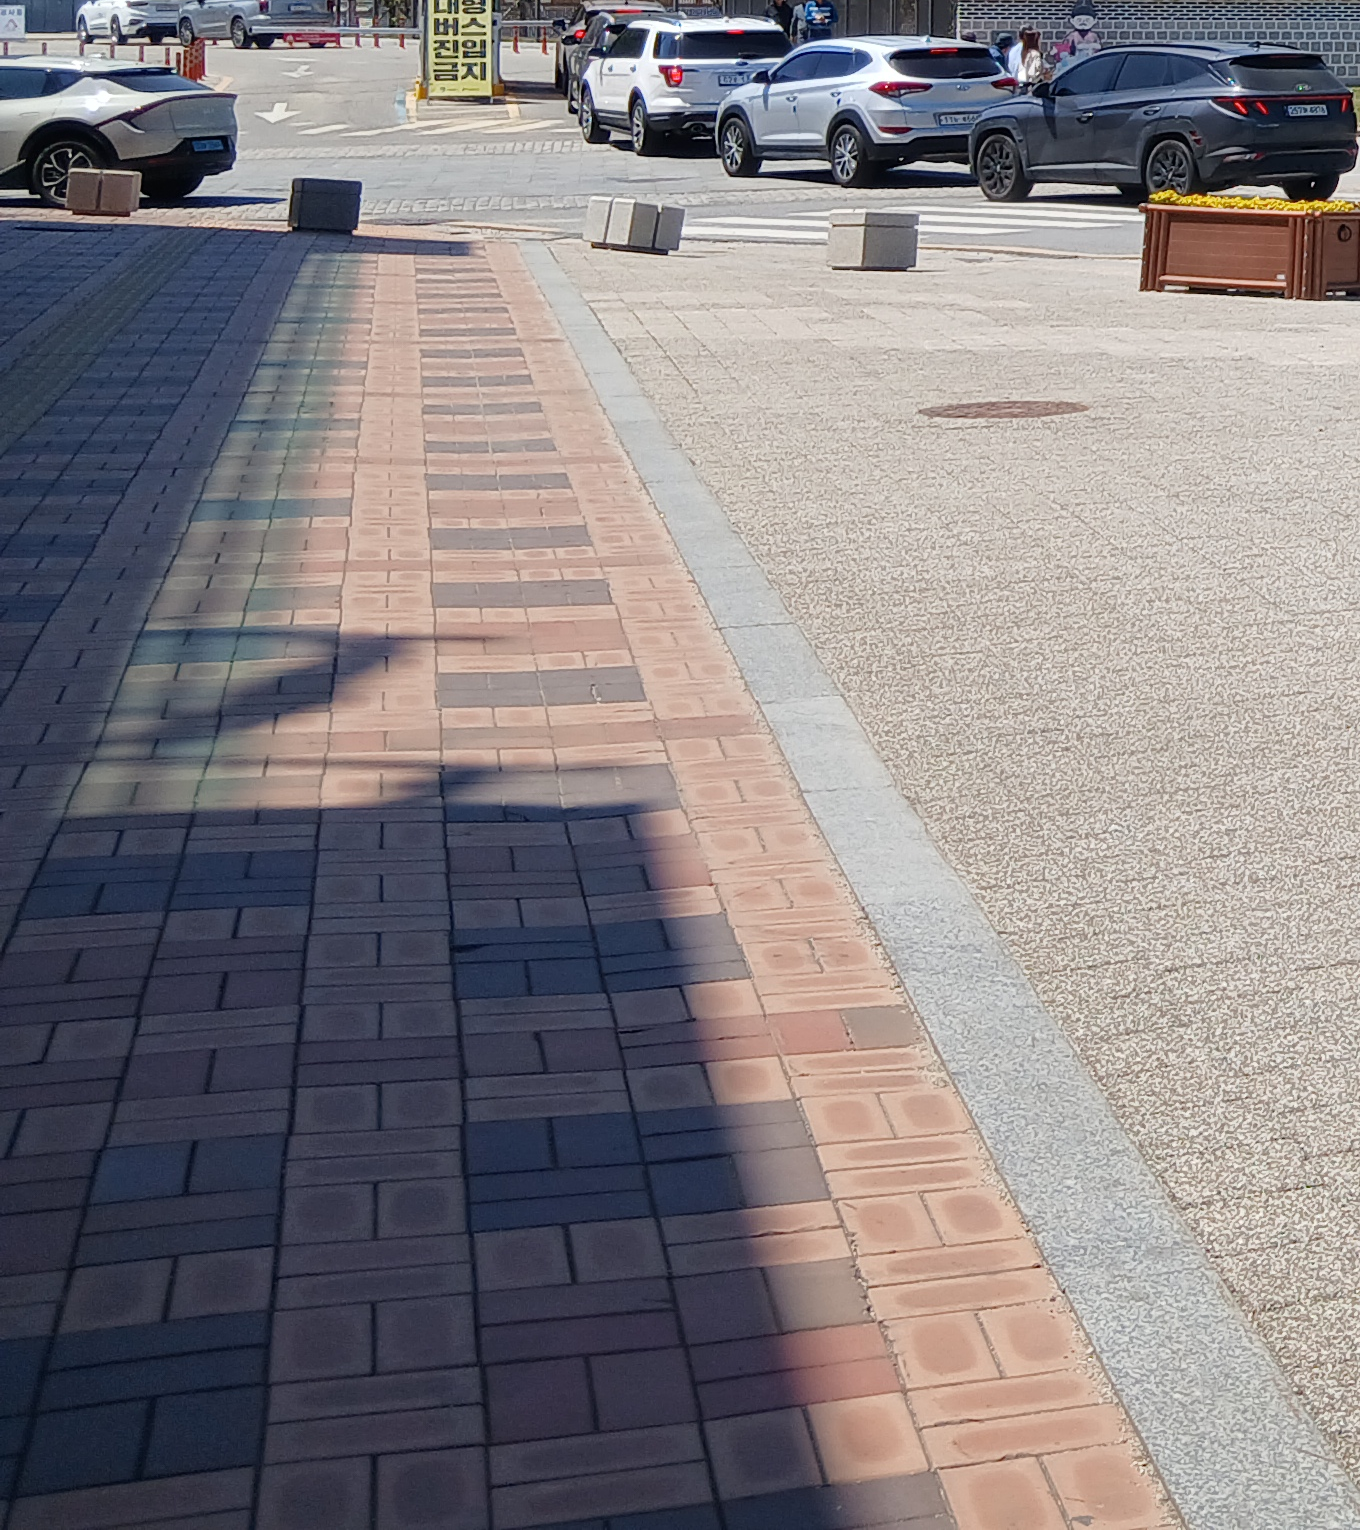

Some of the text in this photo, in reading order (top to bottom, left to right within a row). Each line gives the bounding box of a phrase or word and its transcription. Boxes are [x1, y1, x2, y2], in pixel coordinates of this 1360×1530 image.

[433, 17, 487, 36] 버스
[433, 39, 487, 59] 진입
[433, 62, 487, 81] 금지
